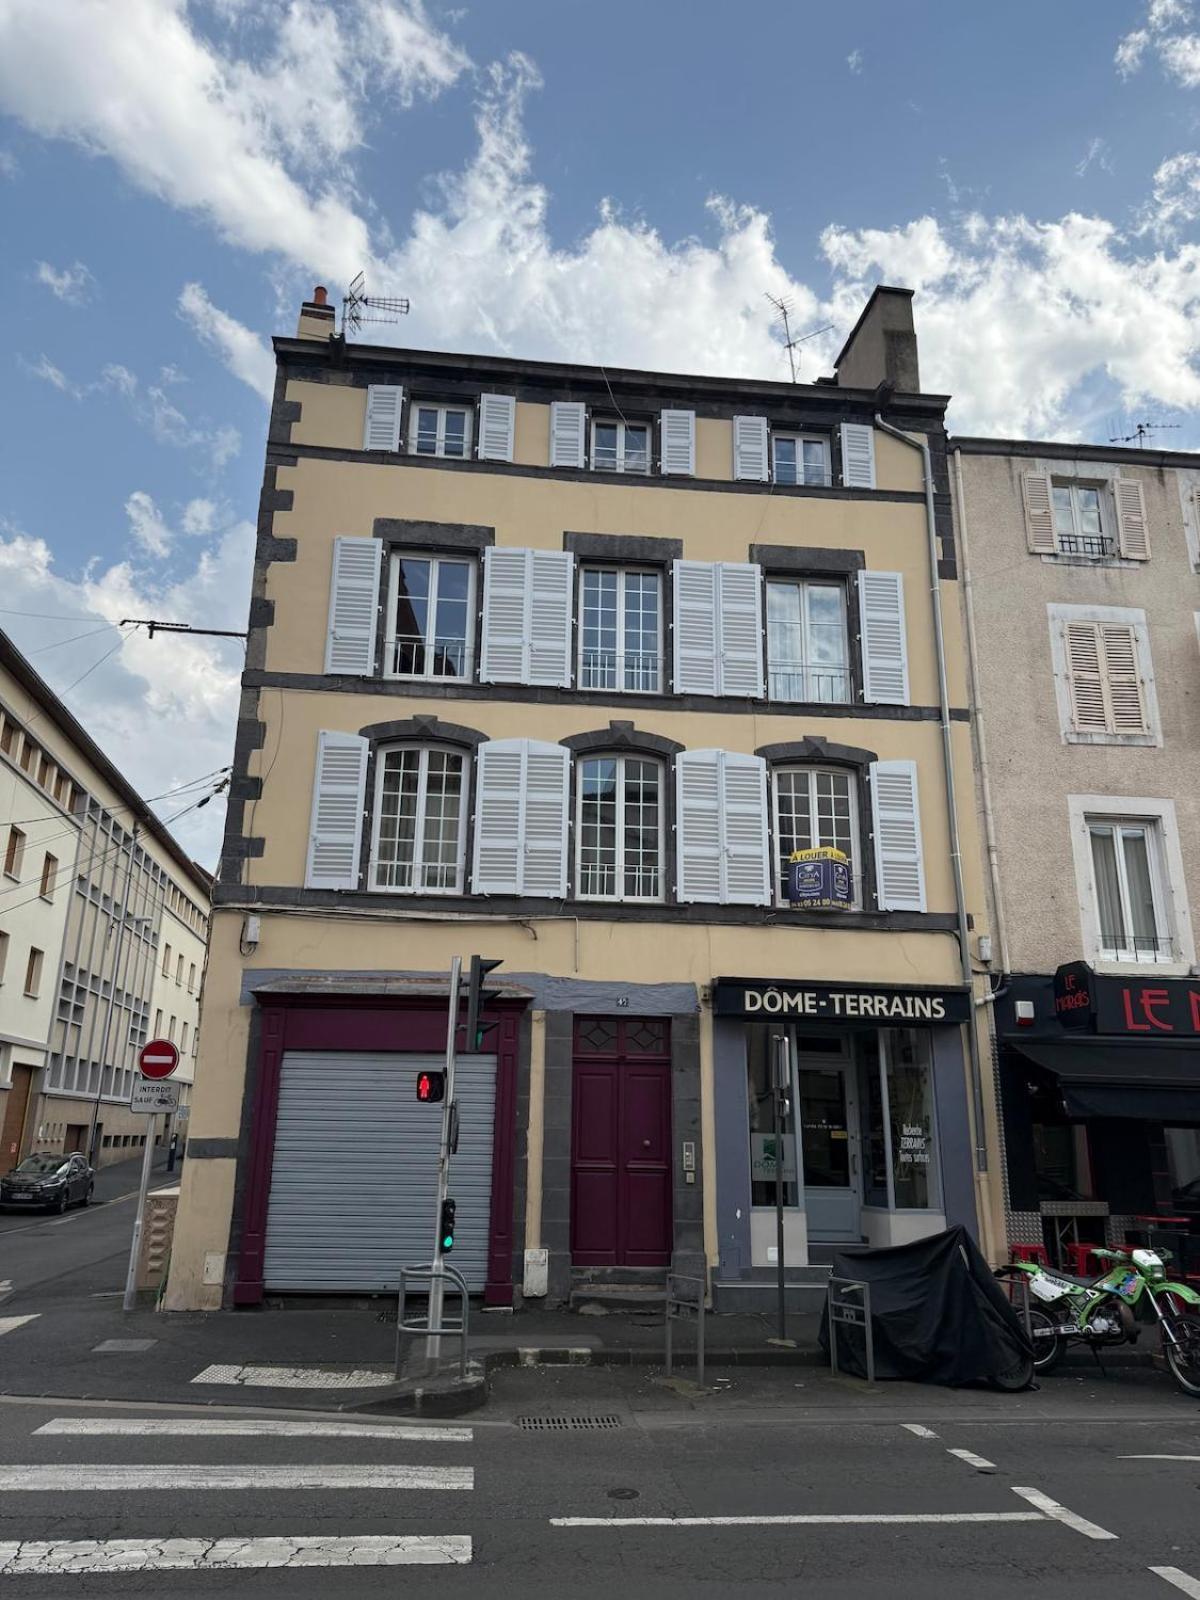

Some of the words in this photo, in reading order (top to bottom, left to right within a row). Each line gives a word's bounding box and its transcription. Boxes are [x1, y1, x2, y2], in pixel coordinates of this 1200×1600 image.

[800, 851, 828, 861] LOUER
[744, 986, 946, 1018] DÔME-TERRAINS
[1121, 988, 1174, 1031] LE
[139, 1086, 172, 1094] INTERDIT
[134, 1096, 154, 1104] SAUF
